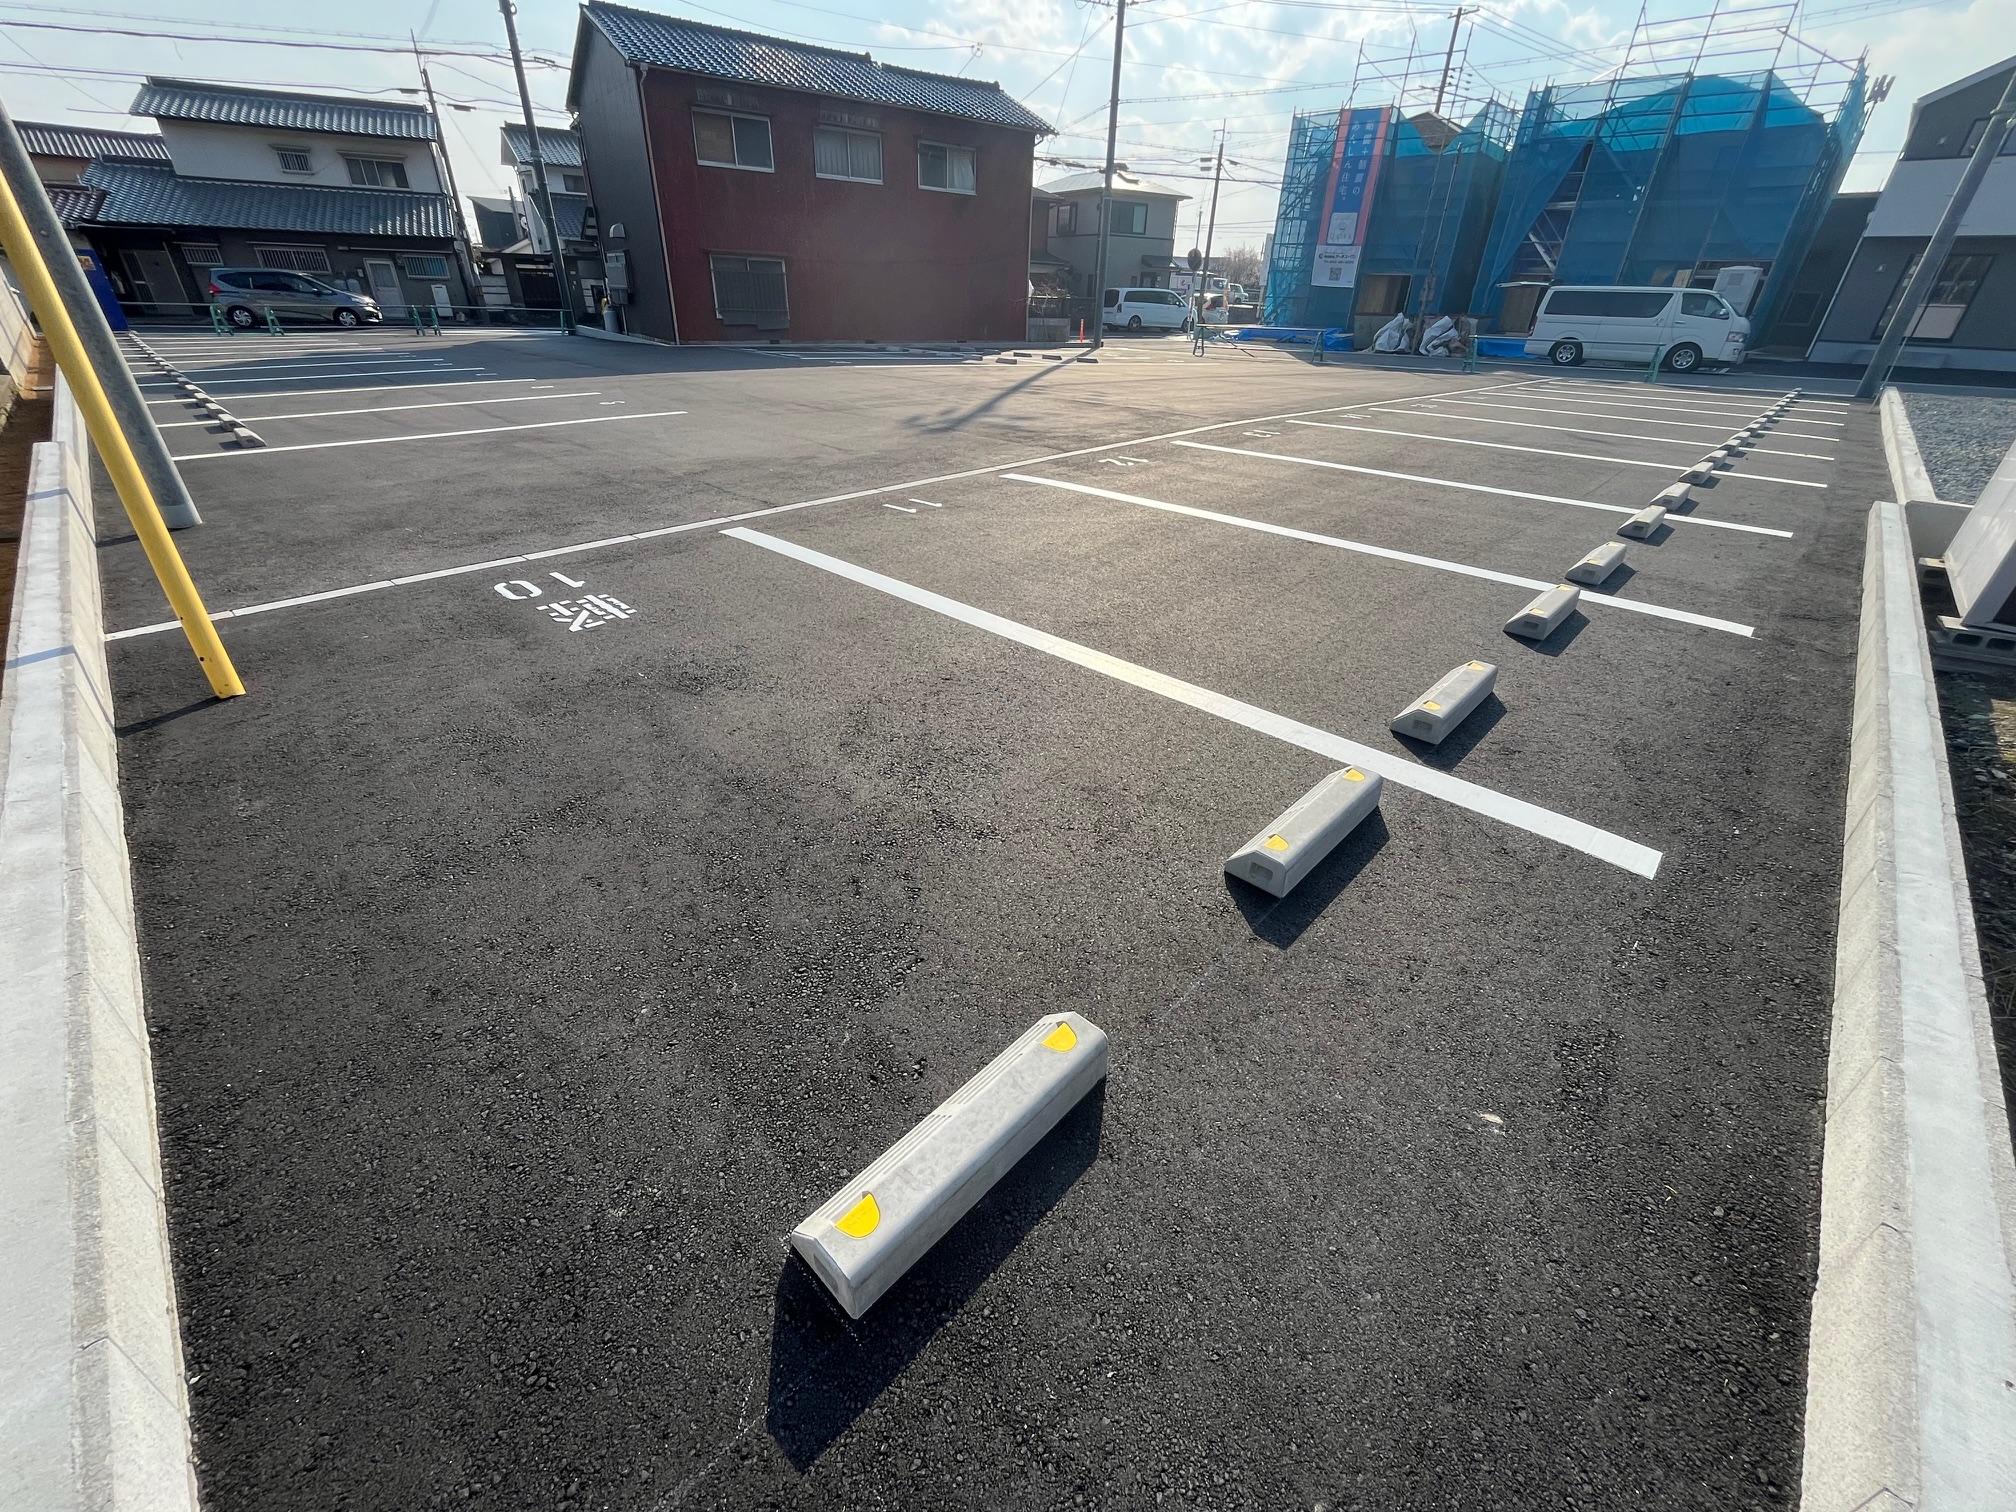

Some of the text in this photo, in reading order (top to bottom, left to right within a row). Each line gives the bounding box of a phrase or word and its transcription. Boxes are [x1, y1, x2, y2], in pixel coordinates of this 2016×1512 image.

[882, 498, 943, 514] 11
[493, 571, 586, 600] 10
[535, 593, 638, 632] 軽
